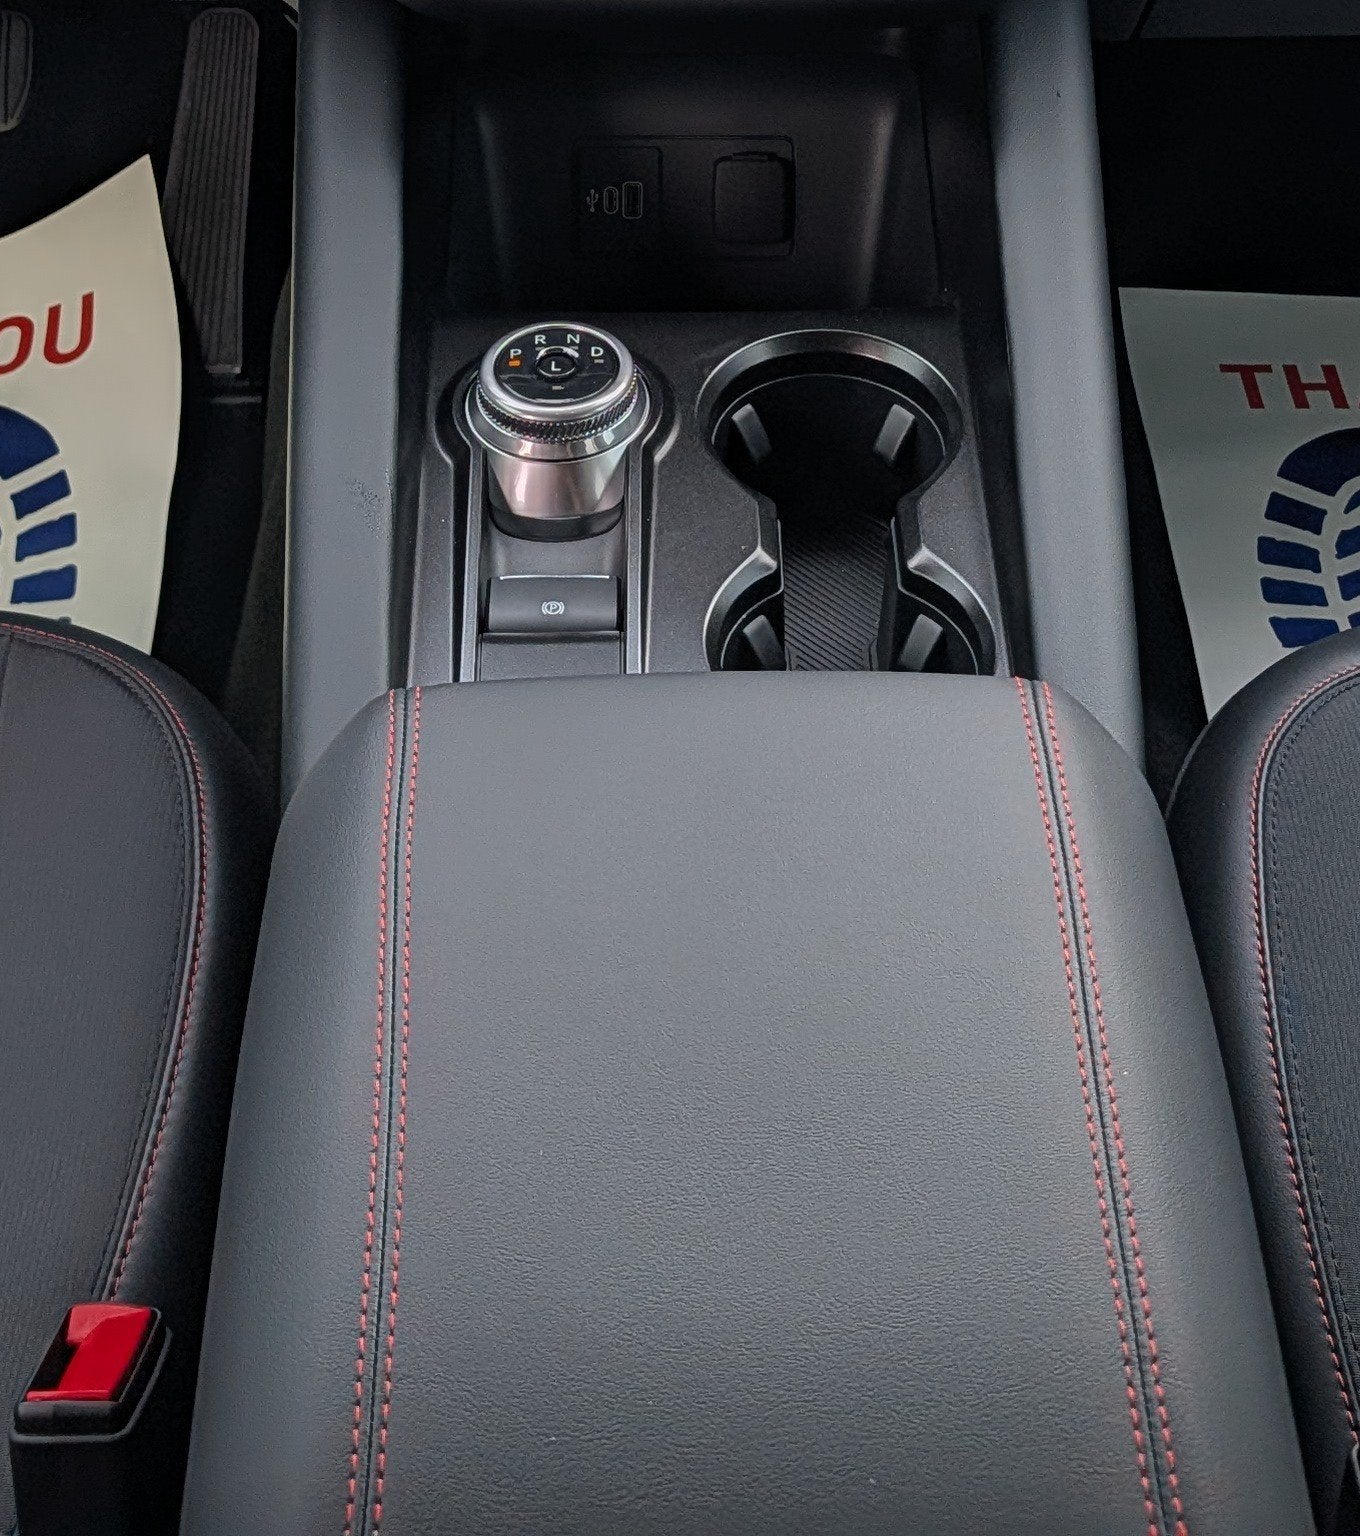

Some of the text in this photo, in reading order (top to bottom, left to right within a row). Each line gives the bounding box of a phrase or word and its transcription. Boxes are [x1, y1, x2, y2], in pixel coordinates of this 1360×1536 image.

[534, 334, 547, 345] R
[567, 333, 580, 344] N
[509, 348, 522, 359] P
[591, 346, 605, 357] D
[551, 360, 562, 372] L
